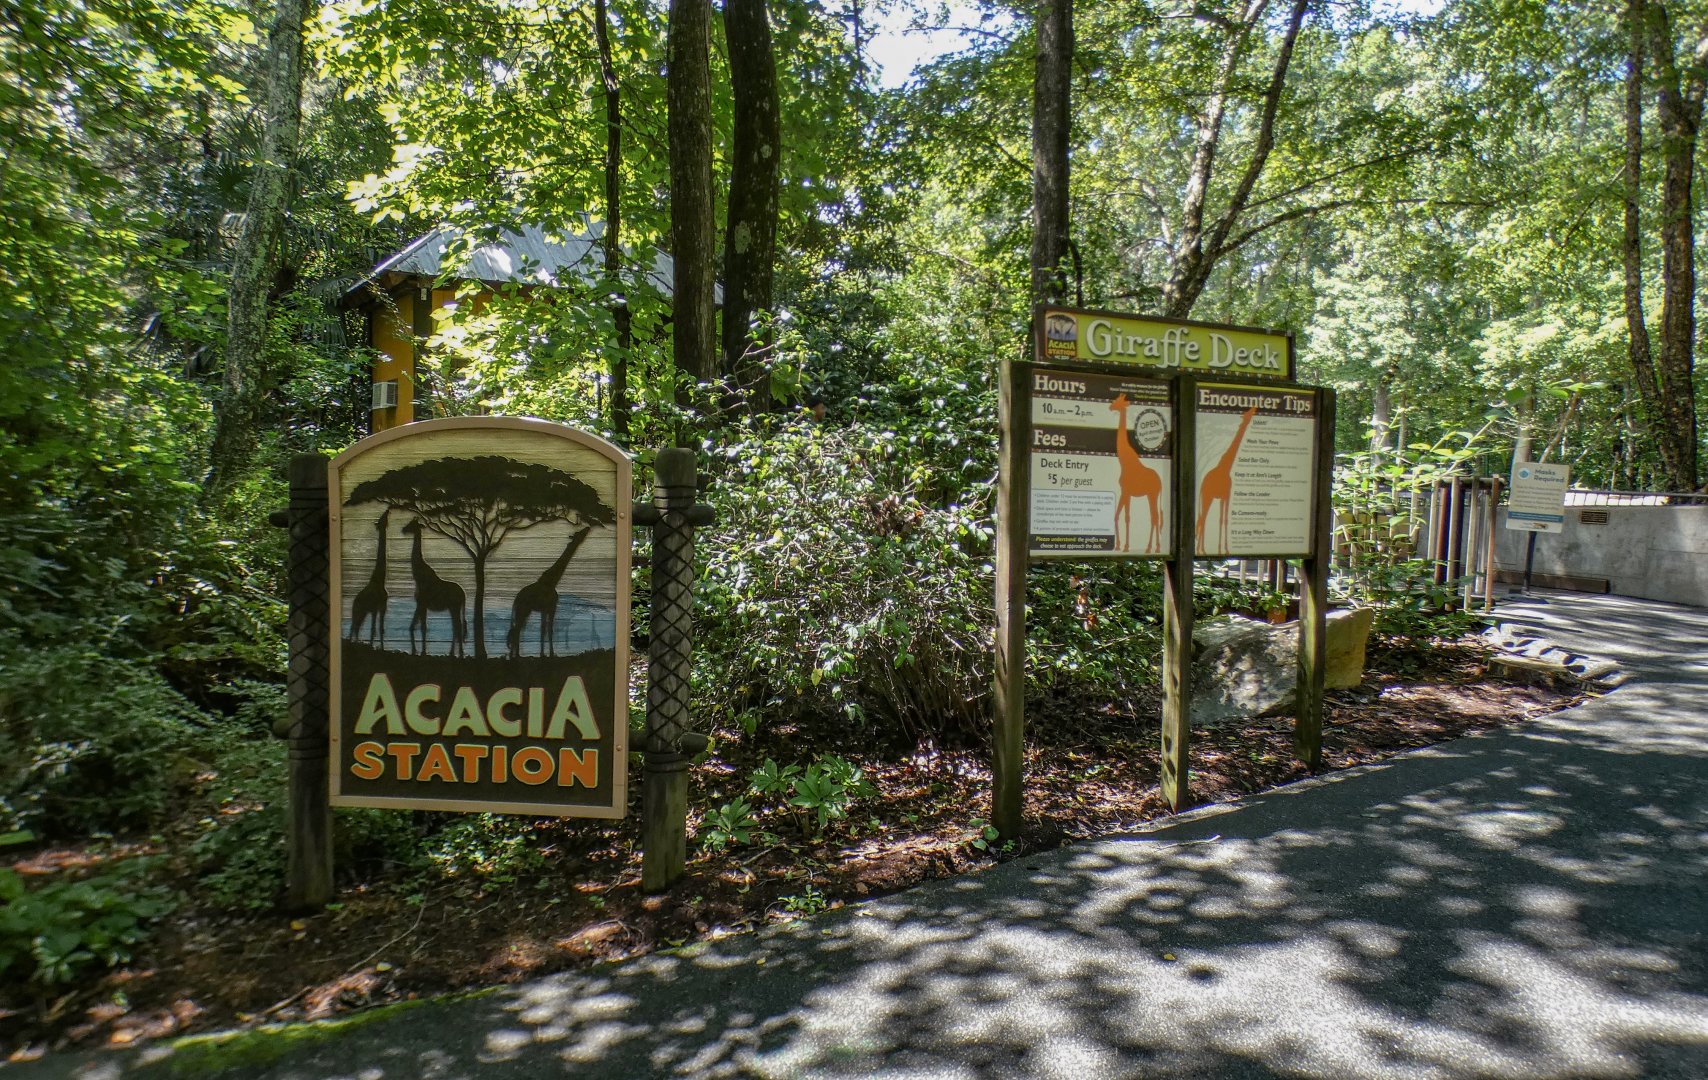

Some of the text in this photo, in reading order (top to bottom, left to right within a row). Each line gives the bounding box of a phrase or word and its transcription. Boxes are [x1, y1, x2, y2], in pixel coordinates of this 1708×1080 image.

[1047, 348, 1076, 356] STATION
[1048, 339, 1075, 349] ACACIA
[1086, 319, 1279, 369] Giraffe Deck
[1034, 374, 1086, 394] Hours
[1199, 389, 1311, 413] Encounter Tips
[1042, 403, 1053, 414] 10
[1075, 405, 1080, 416] 2
[1140, 420, 1160, 430] OPEN
[1033, 429, 1067, 447] Fees
[1040, 458, 1089, 472] Deck Entry
[1048, 473, 1093, 488] $5 per guest
[354, 673, 601, 740] ACACIA
[351, 741, 598, 789] STATION
